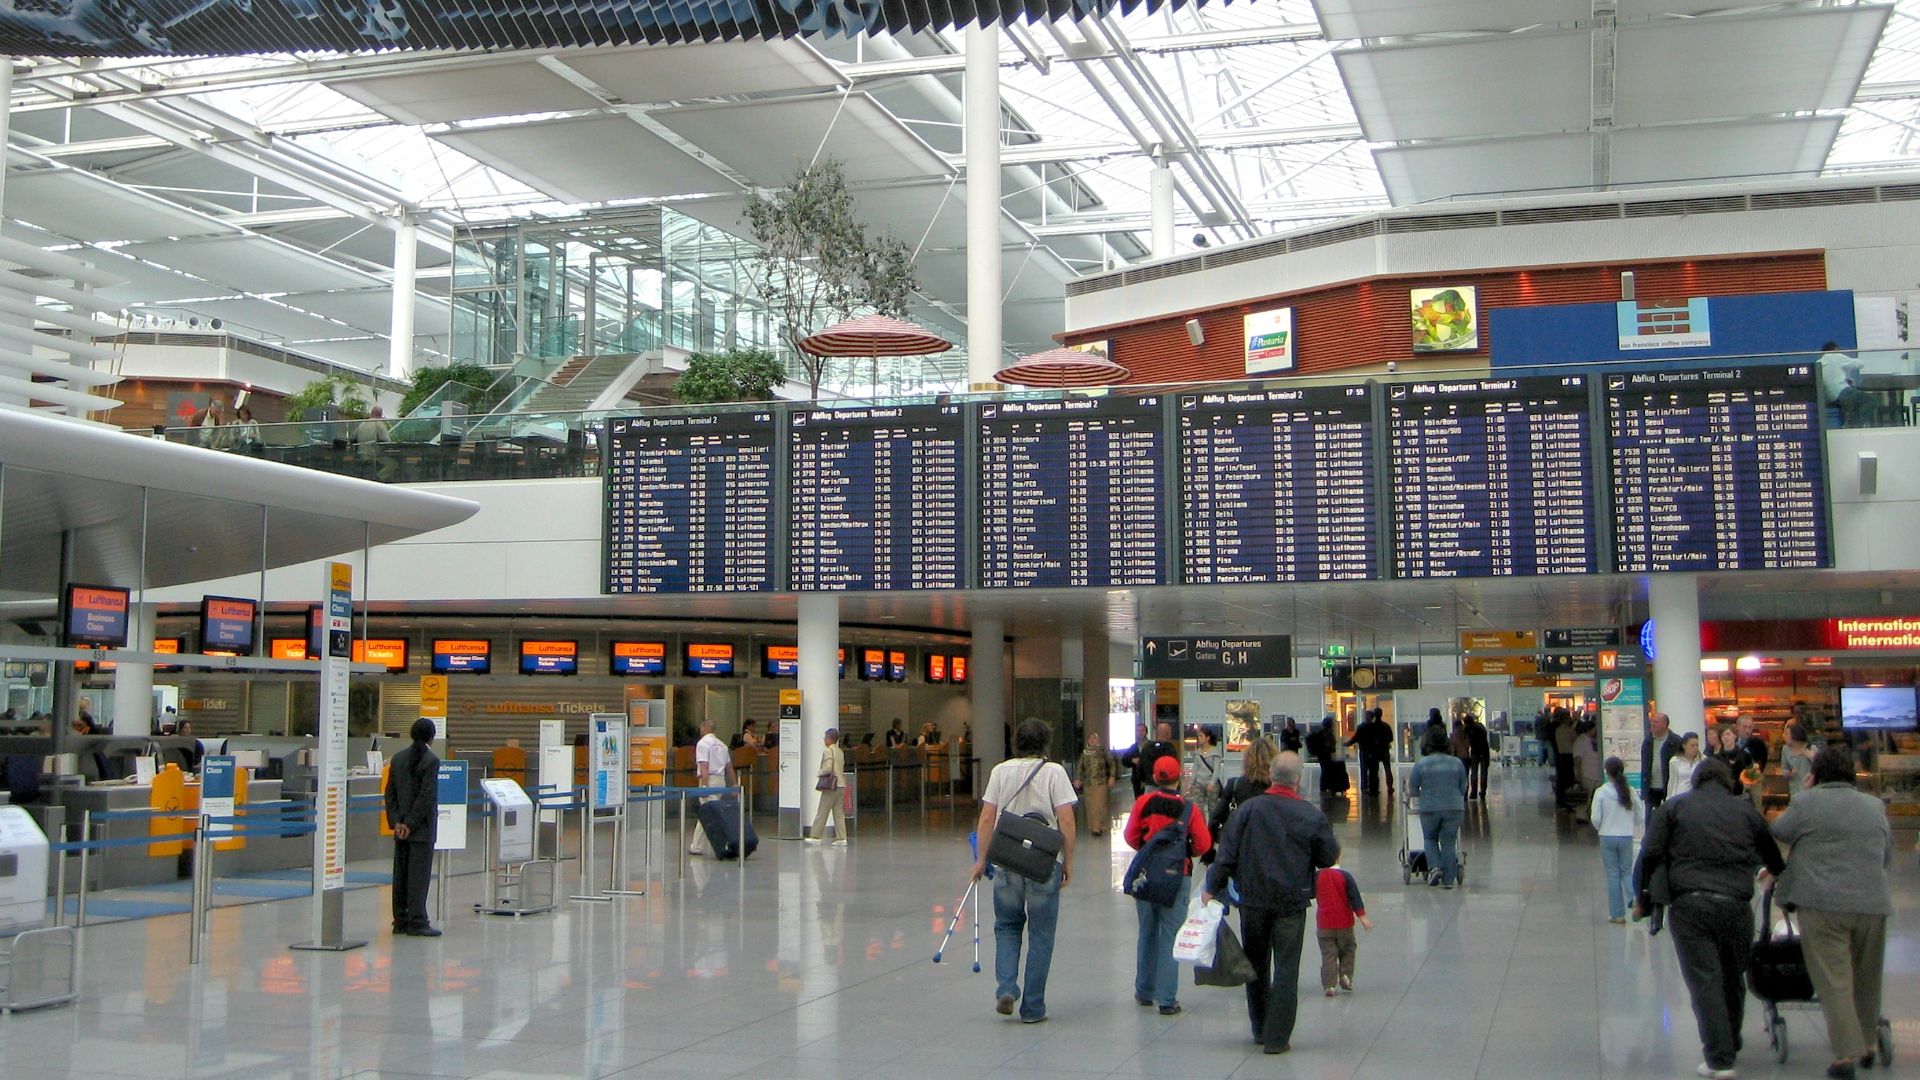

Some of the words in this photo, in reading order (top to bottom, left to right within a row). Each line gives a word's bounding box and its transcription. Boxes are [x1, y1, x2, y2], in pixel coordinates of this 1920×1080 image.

[1632, 375, 1655, 383] Abflug
[1659, 373, 1698, 382] Departures
[1703, 371, 1735, 381] Terminal
[1413, 385, 1435, 394] Abflug
[1439, 383, 1476, 392] Departures
[1480, 381, 1510, 391] Terminal
[1203, 395, 1224, 403] Abflug
[1228, 394, 1264, 402] Departures
[1268, 392, 1296, 401] Terminal
[1003, 404, 1023, 412] Abflug
[1027, 402, 1061, 411] Departures
[812, 412, 832, 420] Abflug
[89, 595, 123, 607] Lufthansa
[332, 594, 350, 604] Business
[222, 606, 250, 616] Lufthansa
[88, 613, 115, 622] Business
[220, 622, 243, 632] Business
[220, 631, 234, 639] Class
[1196, 640, 1219, 649] Abflug
[1222, 640, 1261, 649] Departures
[1196, 652, 1216, 660] Gates
[1222, 652, 1234, 665] G,
[1239, 652, 1247, 664] H
[1603, 654, 1615, 667] M
[1388, 673, 1393, 682] H
[1602, 682, 1619, 696] SHOP
[203, 699, 227, 709] Tickets
[486, 701, 554, 713] Lufthansa
[558, 702, 606, 713] Tickets
